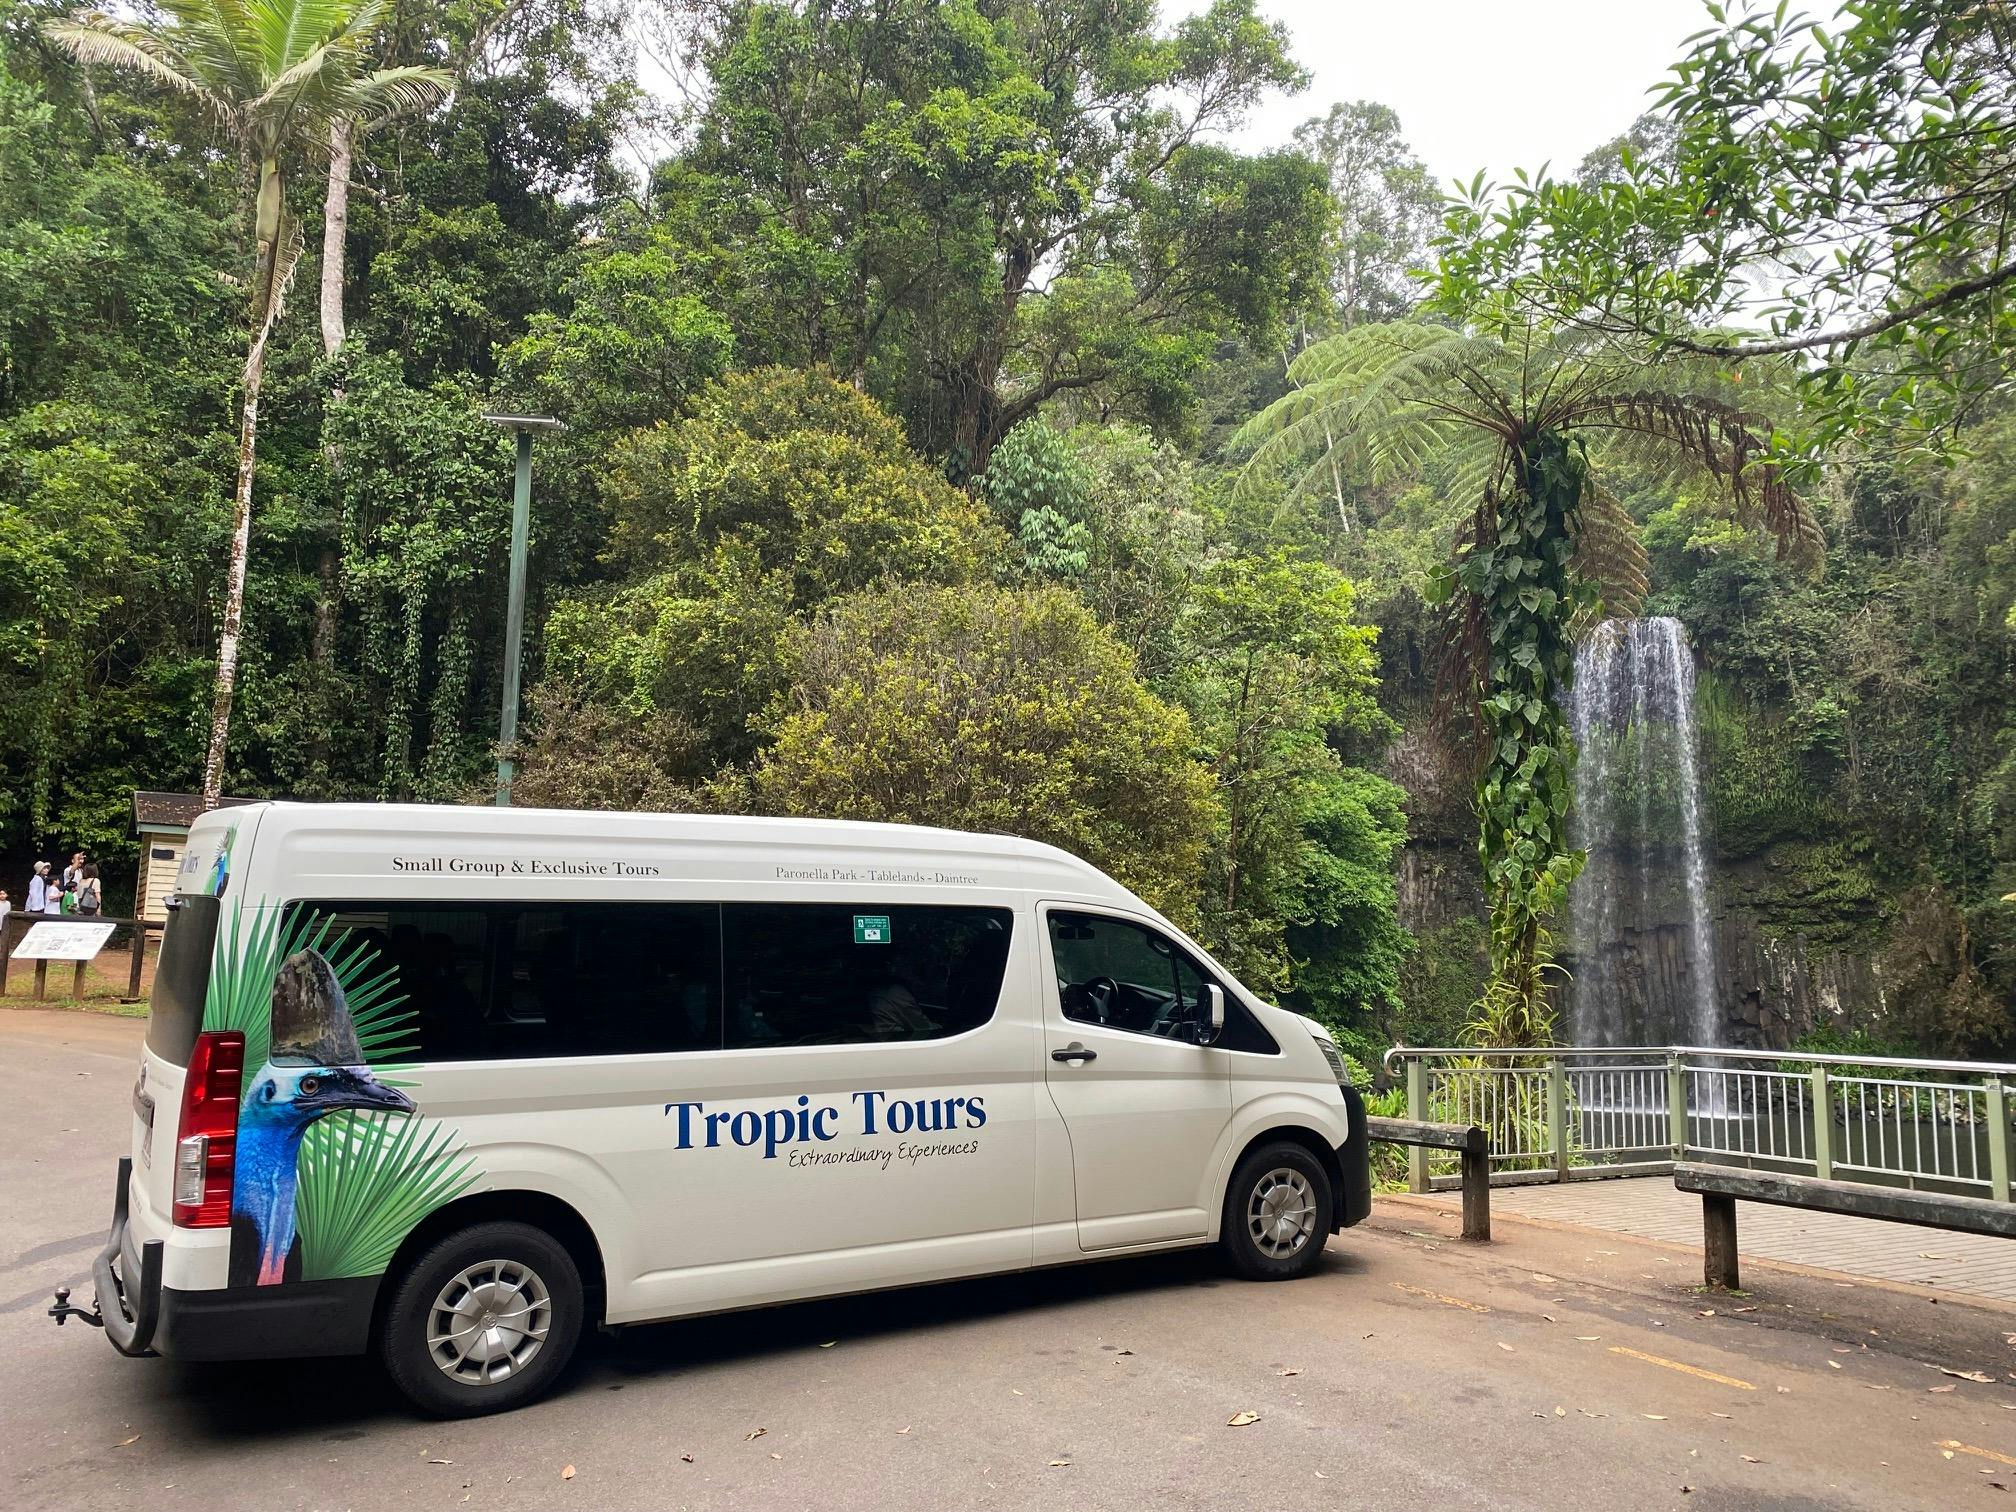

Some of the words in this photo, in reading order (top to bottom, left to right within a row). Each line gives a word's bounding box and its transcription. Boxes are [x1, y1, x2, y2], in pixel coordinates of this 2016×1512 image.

[392, 857, 443, 872] Small
[449, 858, 505, 876] Group
[511, 860, 524, 873] &
[531, 860, 608, 875] Exclusive
[612, 861, 660, 876] Tours
[776, 867, 829, 880] Paronella
[832, 869, 857, 880] Park
[868, 870, 925, 882] Tablelands
[935, 872, 979, 884] Daintree
[665, 1095, 839, 1159] Tropic
[852, 1091, 987, 1136] Tours
[788, 1149, 894, 1171] Extraordinary
[897, 1139, 979, 1166] Experiences
